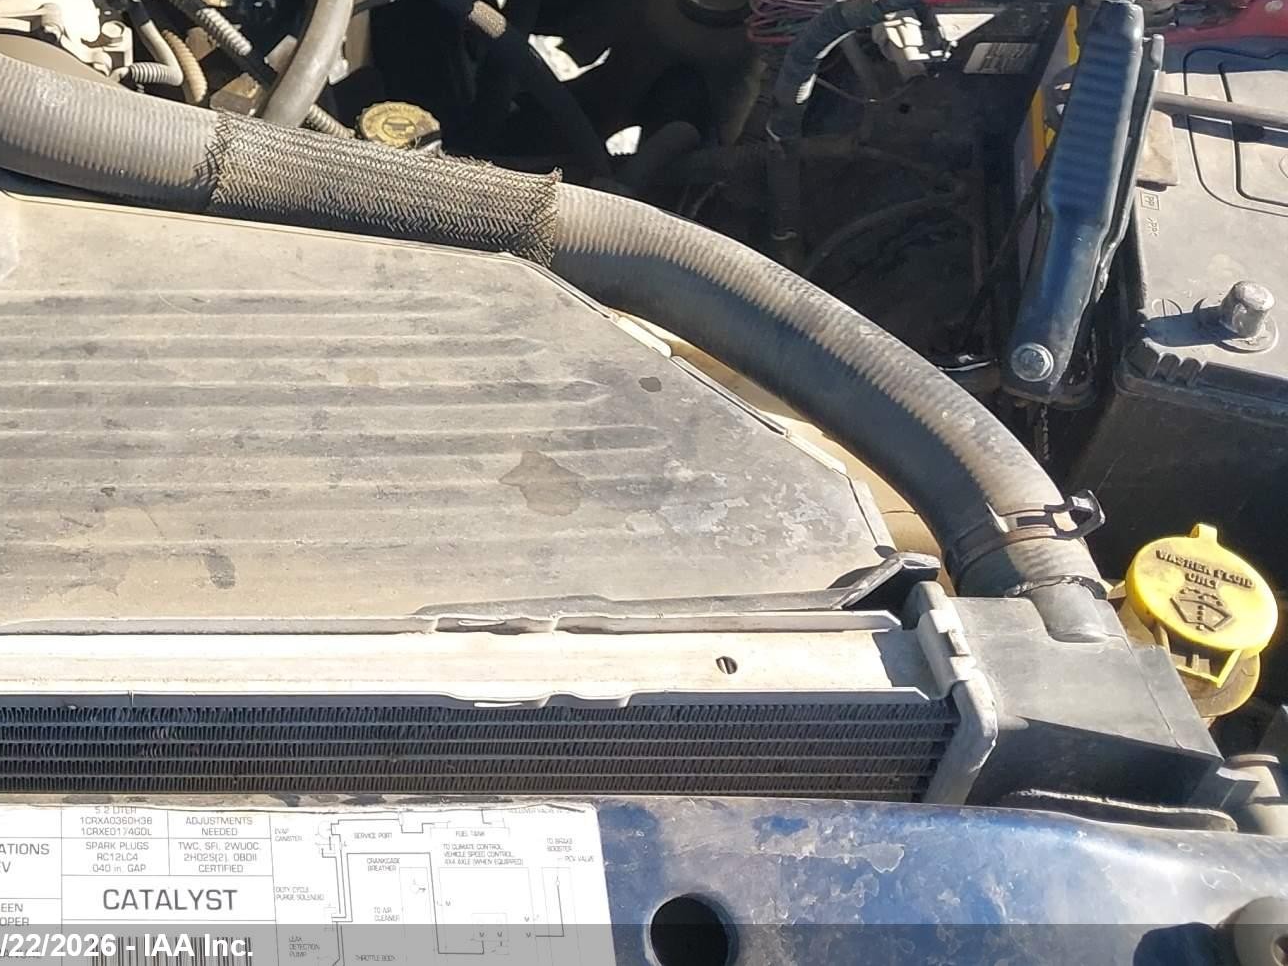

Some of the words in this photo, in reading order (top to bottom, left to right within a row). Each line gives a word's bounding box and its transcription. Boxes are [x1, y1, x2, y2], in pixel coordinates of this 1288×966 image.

[1155, 549, 1211, 576] WASHER
[1213, 568, 1254, 589] FLUID
[1185, 572, 1217, 589] ONLY
[185, 817, 253, 825] ADJUSTMENTS
[201, 827, 238, 836] NEEDED
[85, 841, 116, 850] SPARK
[120, 841, 150, 850] PLUGS
[127, 864, 147, 873] GAP
[199, 864, 244, 873] CERTIFIED
[103, 889, 238, 911] CATALYST
